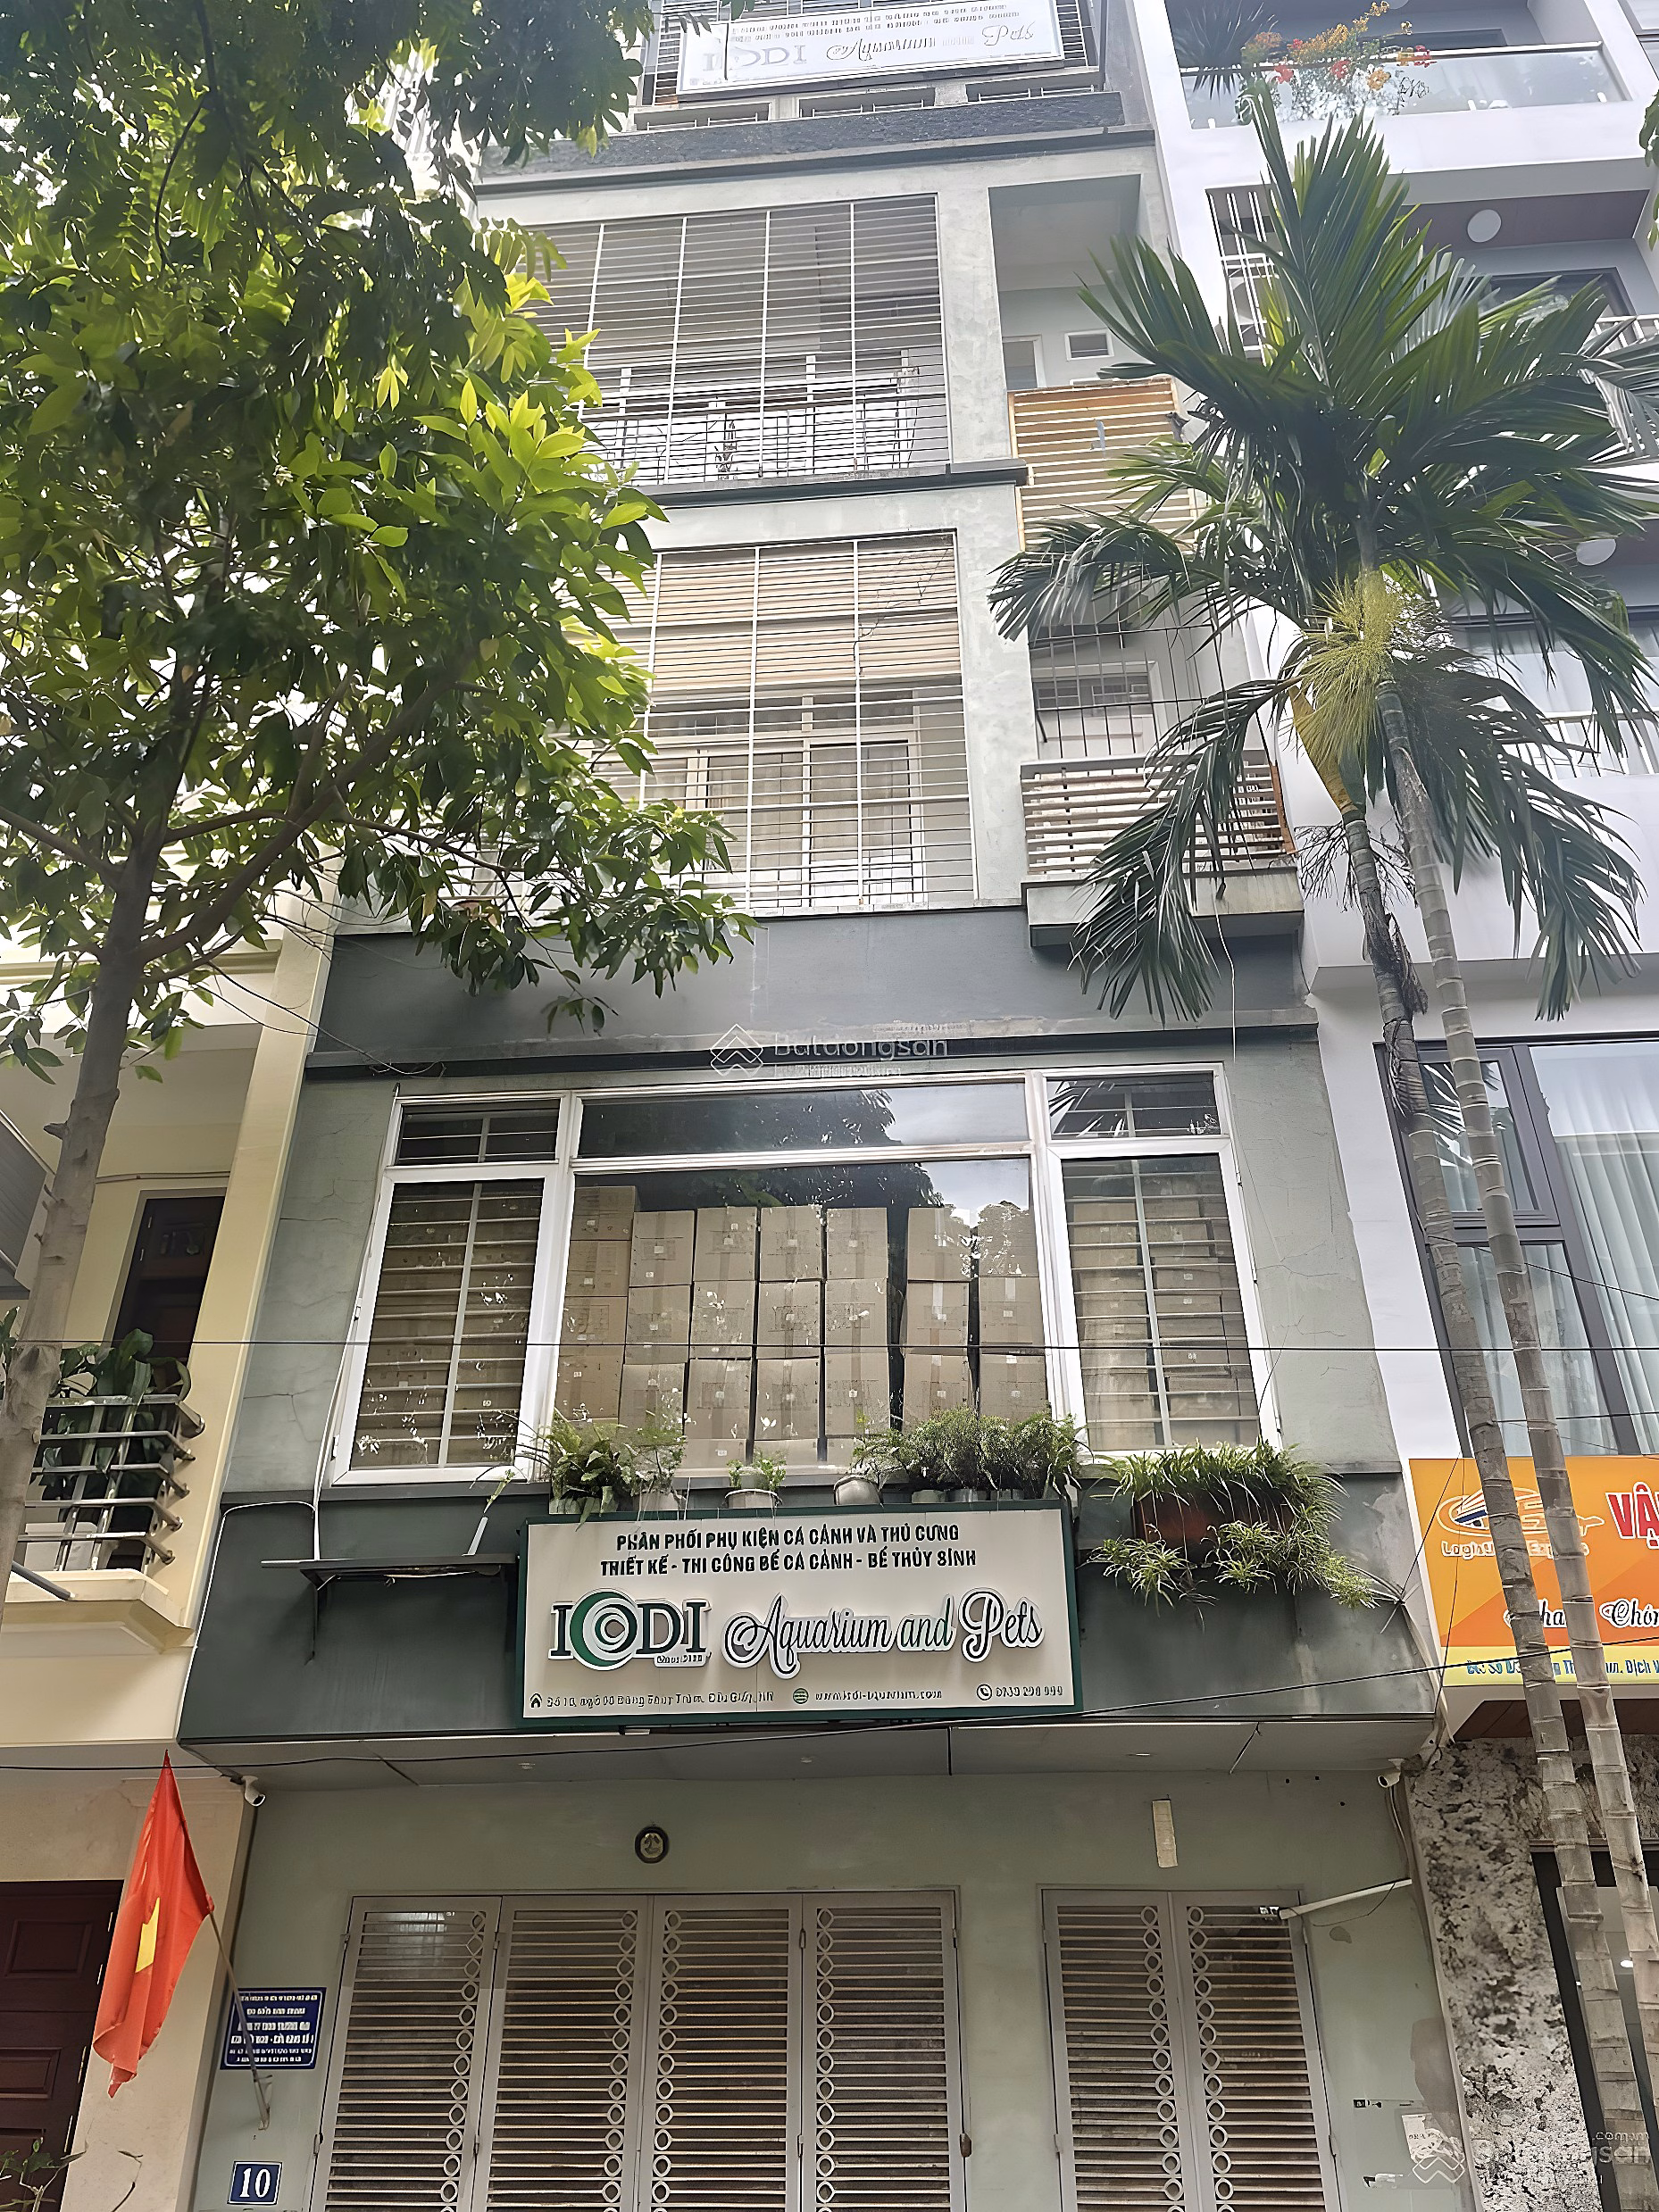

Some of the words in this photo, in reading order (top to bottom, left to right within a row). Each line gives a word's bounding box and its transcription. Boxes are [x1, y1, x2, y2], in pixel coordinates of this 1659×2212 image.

[616, 1531, 660, 1551] PHÂN
[664, 1528, 702, 1549] PHỐI
[705, 1530, 738, 1551] PHỤ
[742, 1526, 779, 1549] KIỆN
[783, 1526, 804, 1545] CÁ
[809, 1523, 853, 1545] CẢNH
[856, 1524, 877, 1543] VÀ
[880, 1522, 911, 1543] THỦ
[915, 1524, 959, 1542] CƯNG
[600, 1554, 645, 1576] THIẾT
[647, 1553, 670, 1575] KẾ
[681, 1557, 707, 1574] THI
[711, 1552, 755, 1573] CÔNG
[783, 1551, 805, 1571] CÁ
[809, 1548, 853, 1570] CẢNH
[891, 1546, 933, 1568] THỦY
[937, 1547, 977, 1567] SINH
[724, 1594, 893, 1675] Aquarium
[900, 1597, 955, 1650] and
[960, 1590, 1044, 1659] Pets
[239, 2167, 271, 2198] 10
